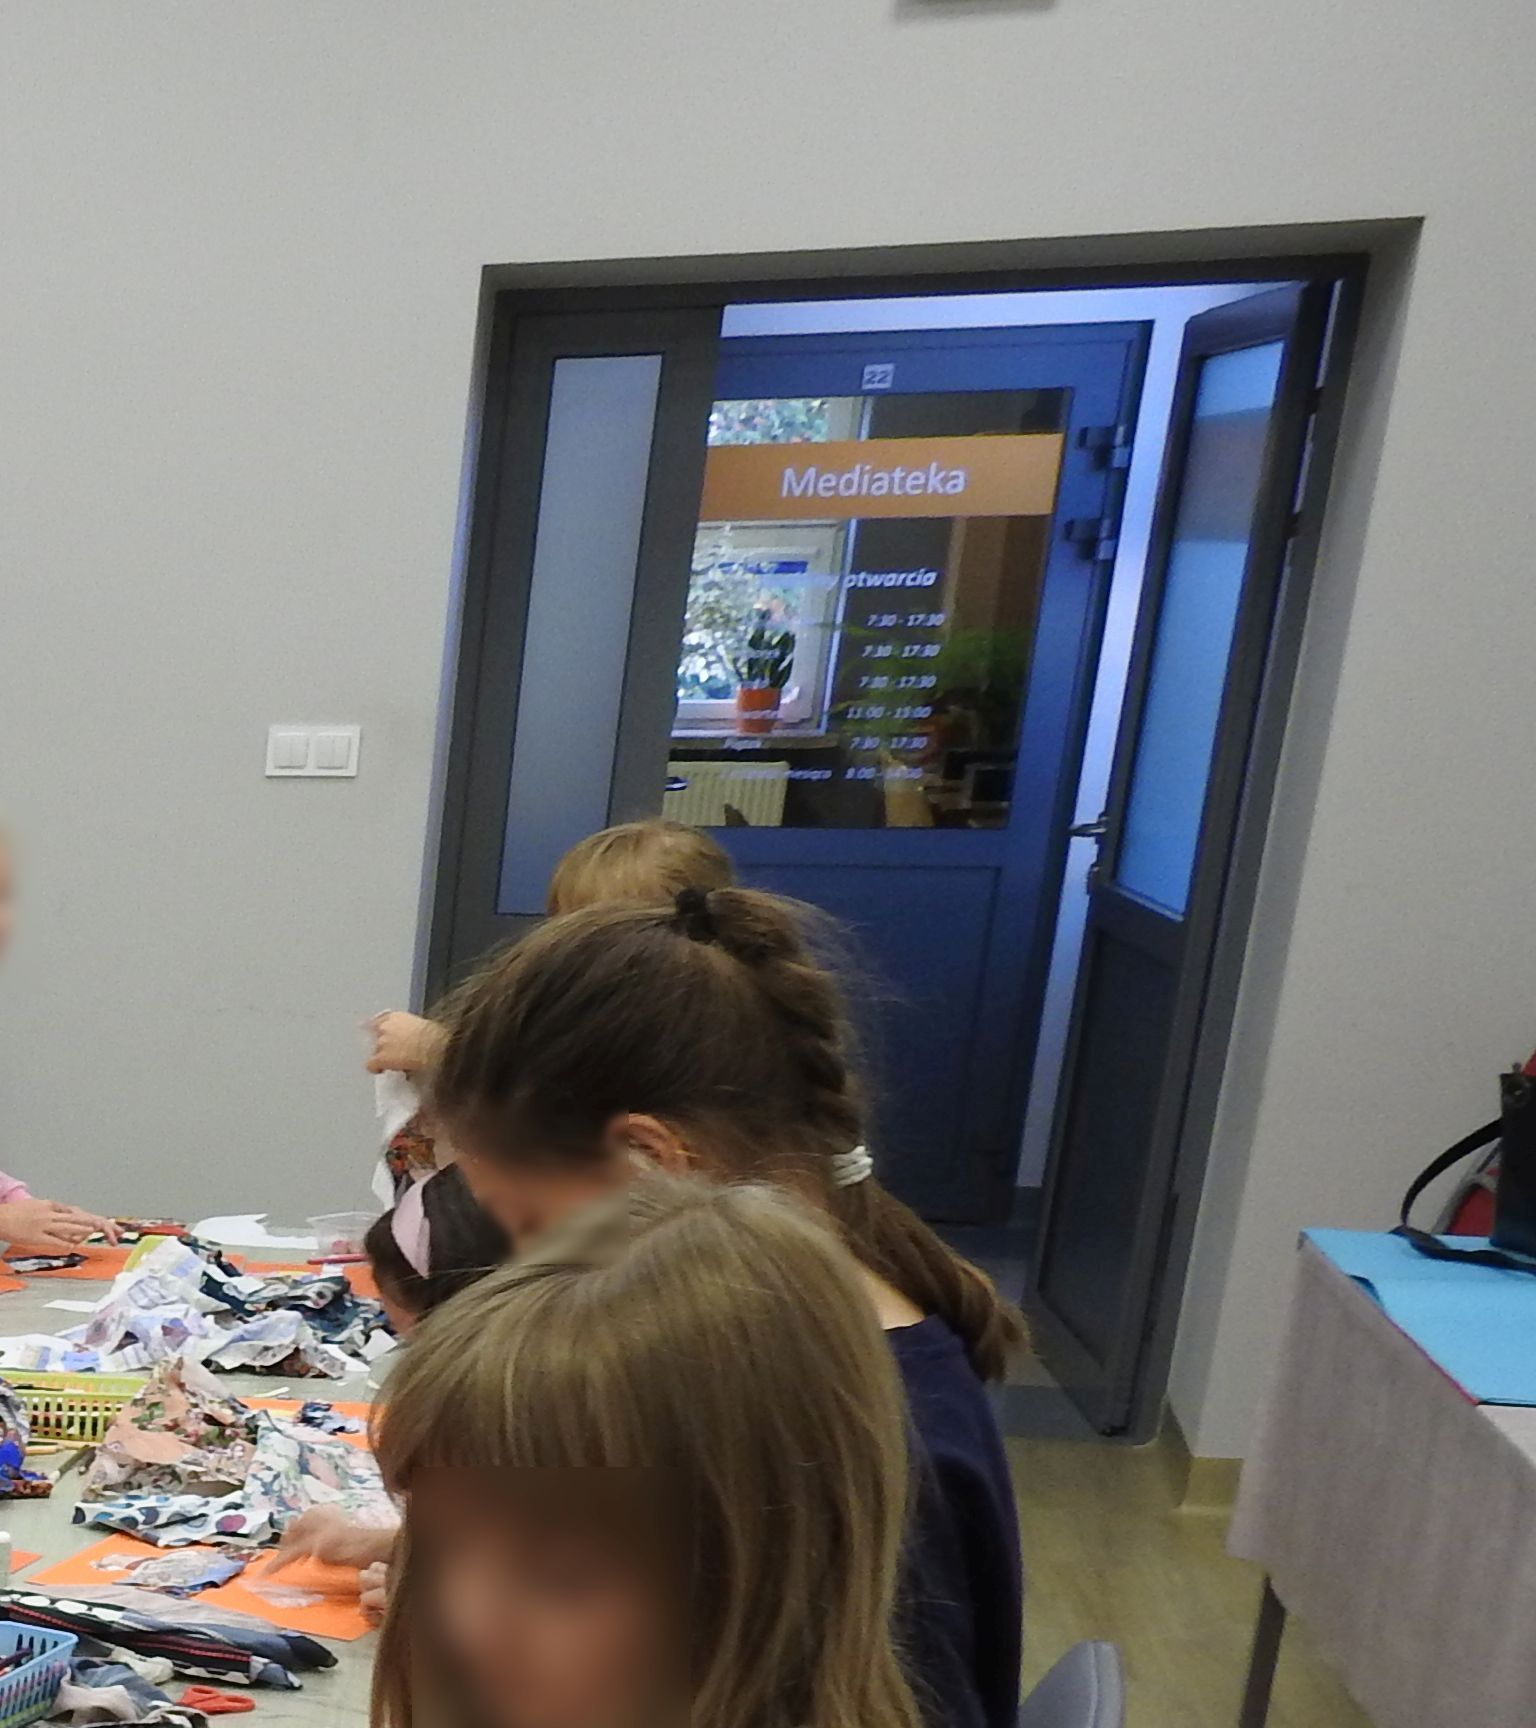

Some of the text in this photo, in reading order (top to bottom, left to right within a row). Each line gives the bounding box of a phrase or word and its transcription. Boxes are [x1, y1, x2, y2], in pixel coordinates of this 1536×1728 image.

[864, 370, 889, 384] 22
[781, 462, 966, 498] Mediateka
[845, 568, 937, 588] otwarcia
